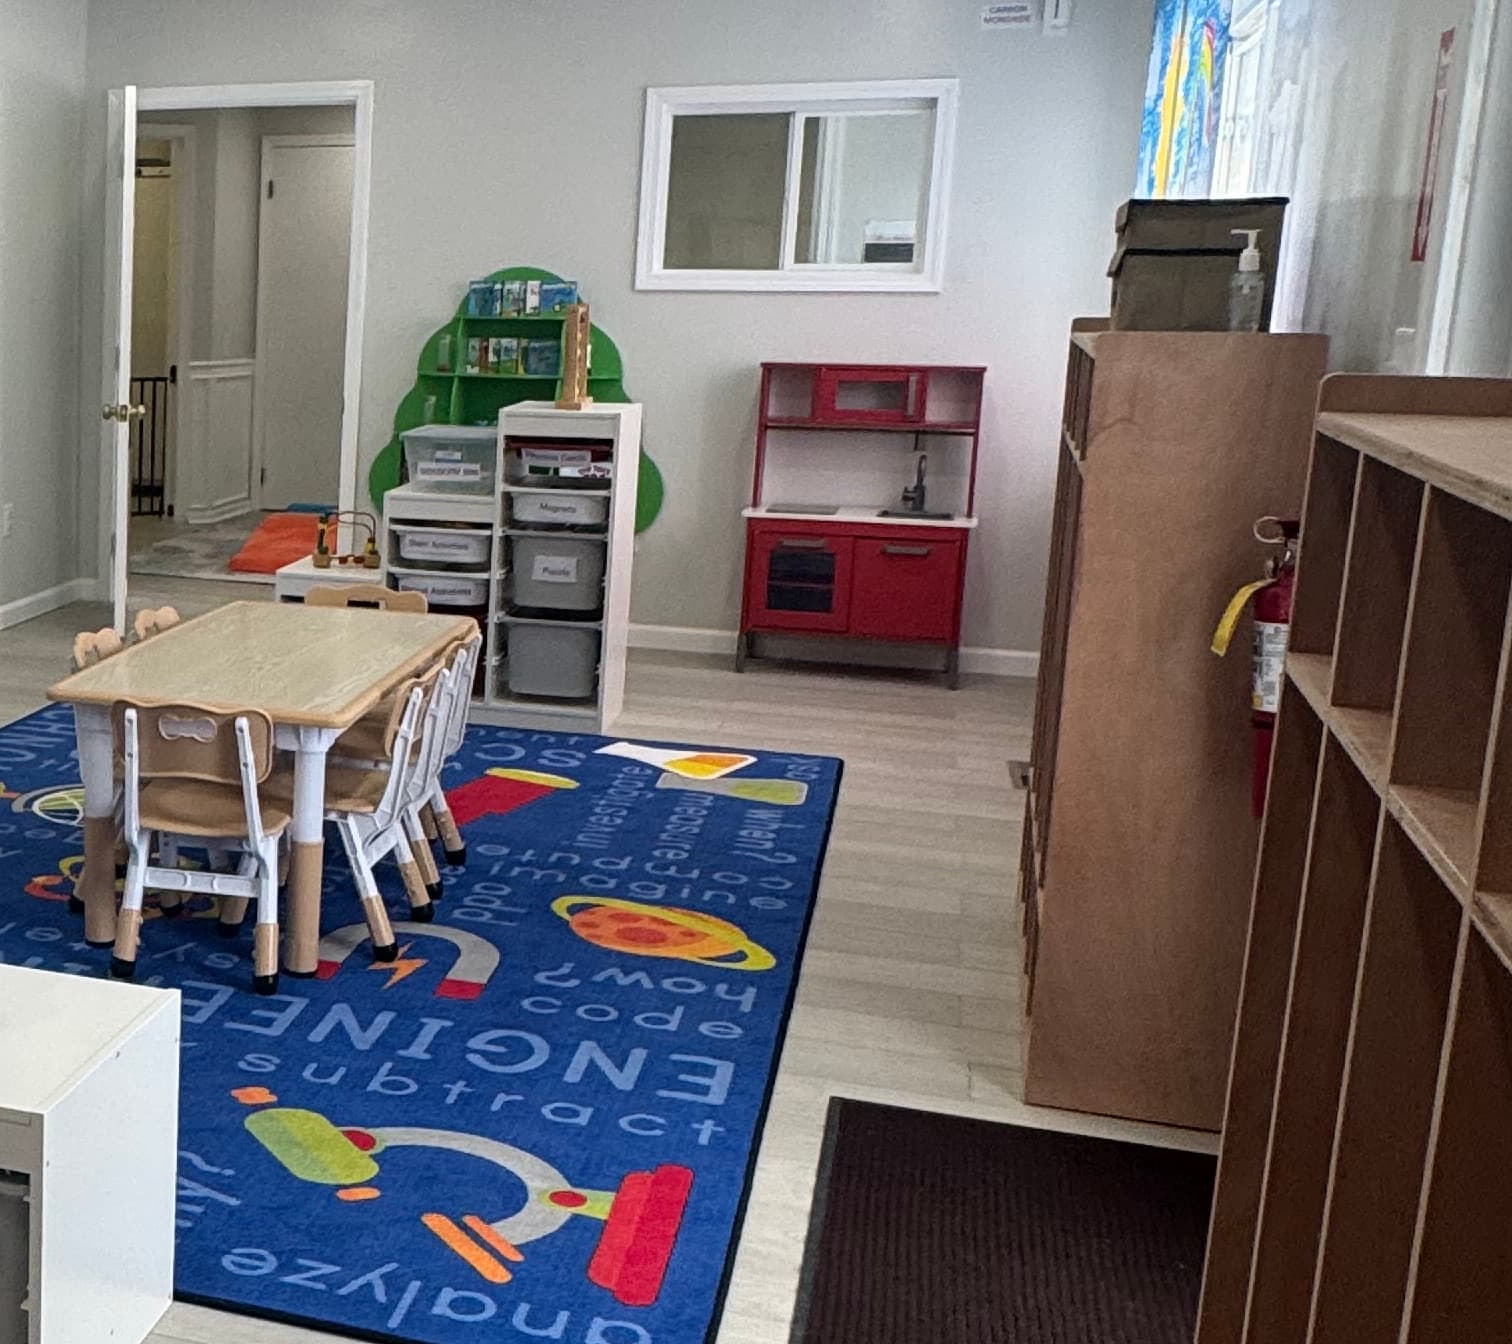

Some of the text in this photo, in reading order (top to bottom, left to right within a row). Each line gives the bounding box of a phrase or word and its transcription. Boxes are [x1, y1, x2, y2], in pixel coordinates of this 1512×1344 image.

[651, 791, 716, 862] measure
[450, 880, 528, 927] add
[533, 961, 758, 1014] how?
[520, 996, 745, 1040] code
[236, 1052, 726, 1146] subtract
